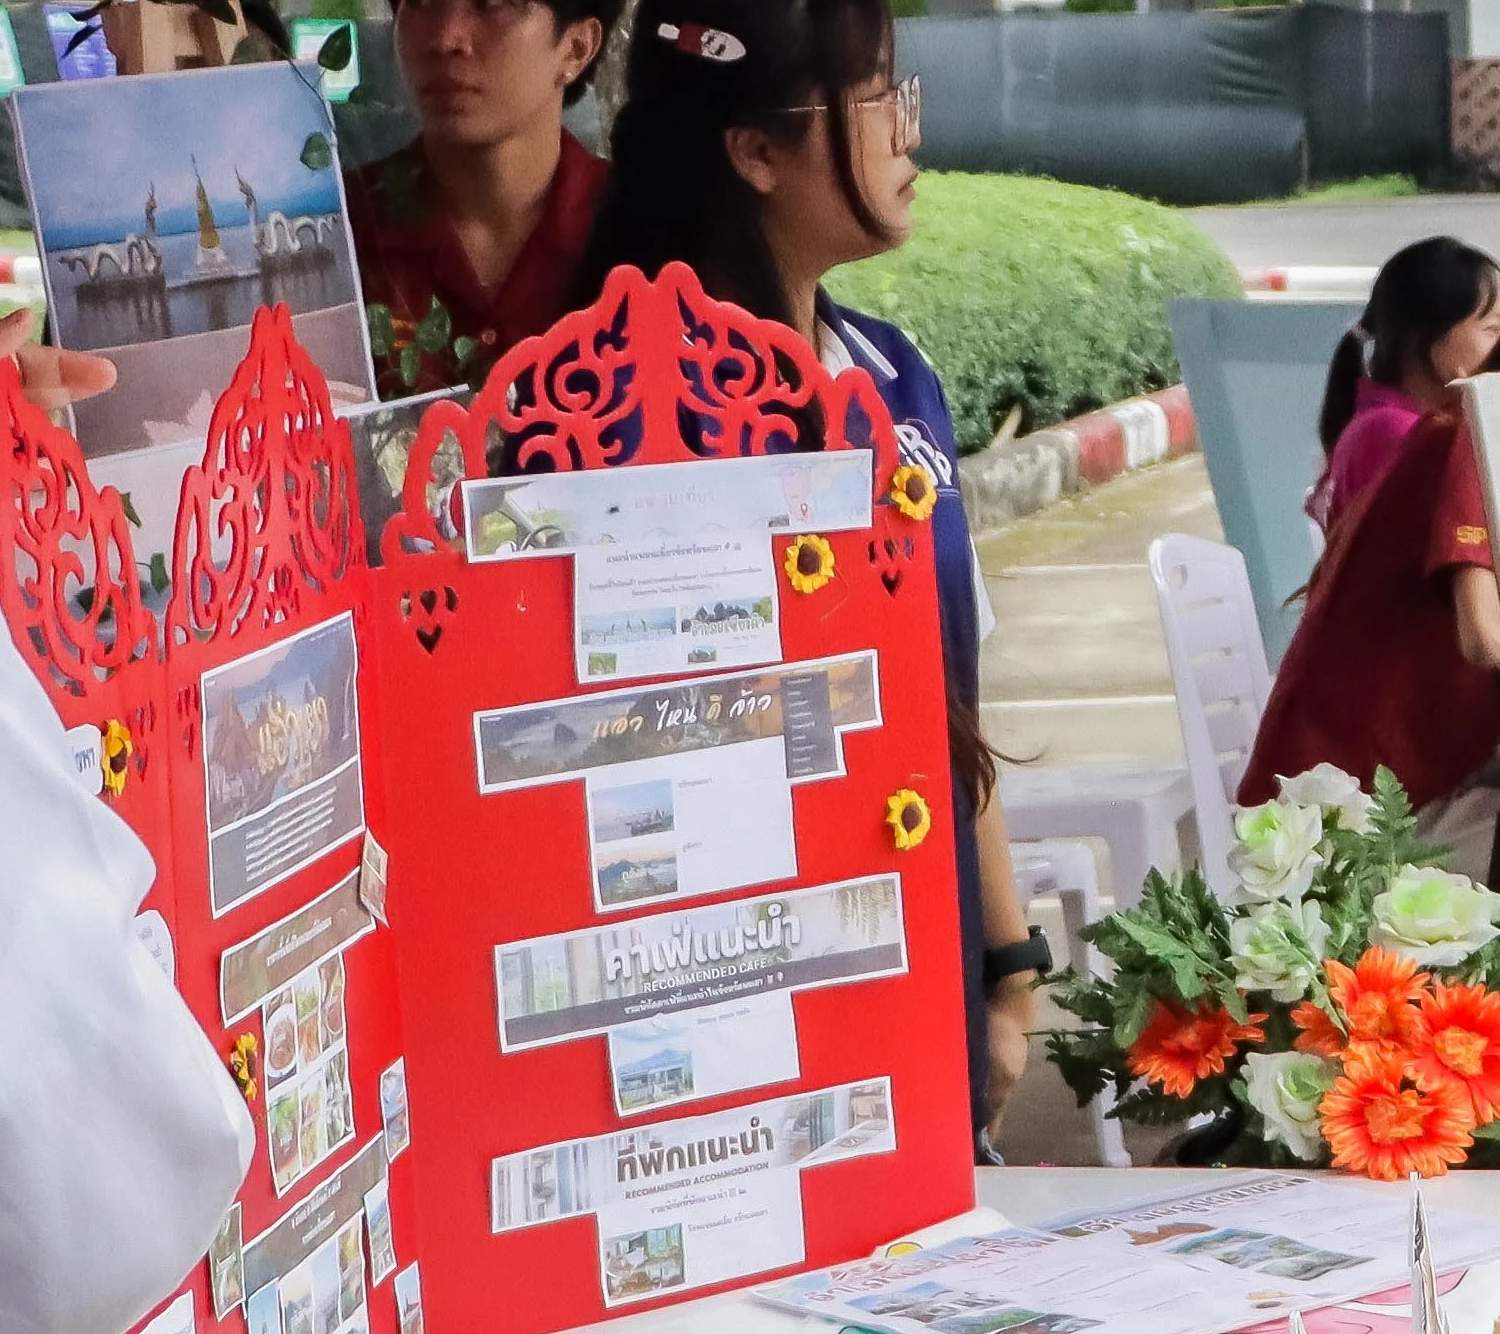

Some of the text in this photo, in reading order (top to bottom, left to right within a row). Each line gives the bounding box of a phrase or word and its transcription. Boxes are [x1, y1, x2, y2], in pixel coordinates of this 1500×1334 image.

[605, 901, 803, 983] คาเฟ่แนะนำ
[642, 955, 768, 994] RECOMMENDED CAFE
[615, 1115, 775, 1184] ที่พักแนะนำ
[624, 1178, 692, 1200] RECOMMENDED
